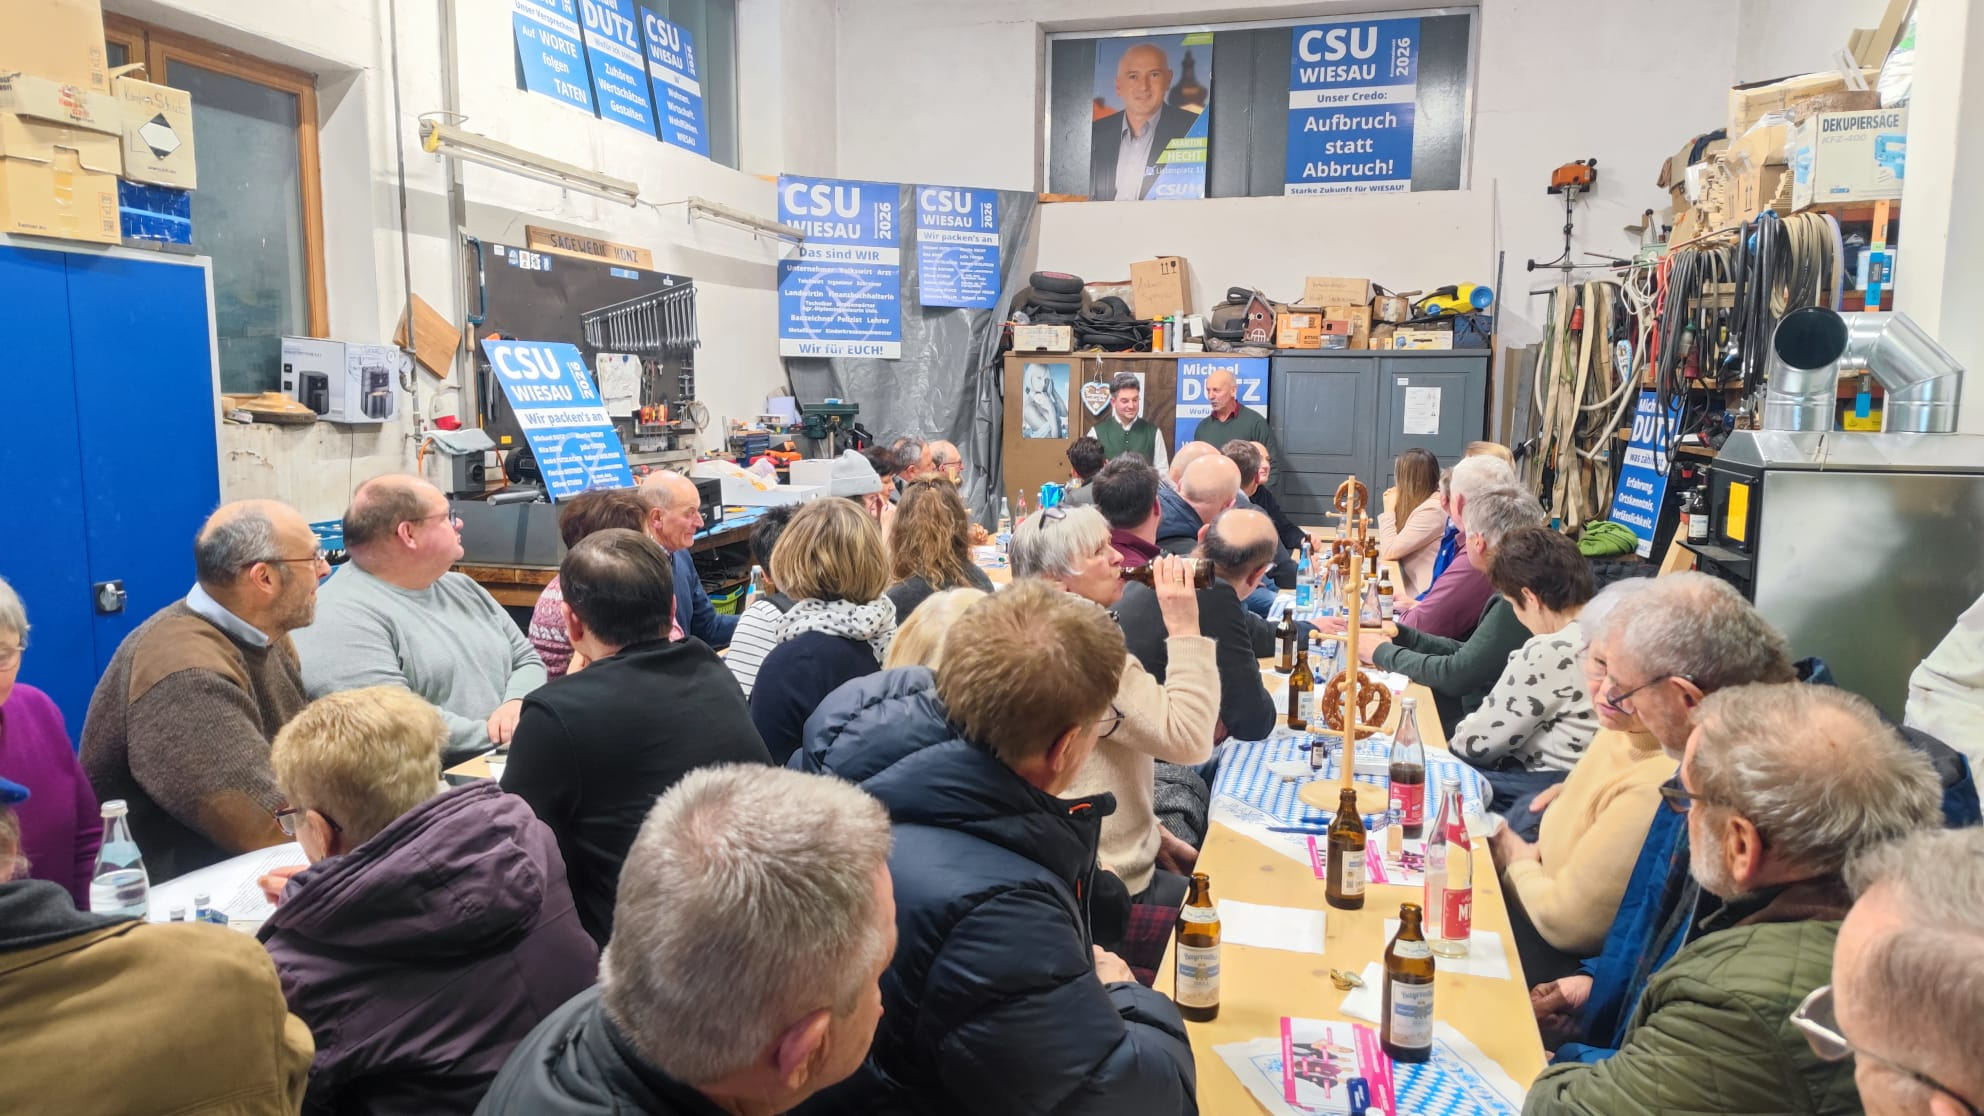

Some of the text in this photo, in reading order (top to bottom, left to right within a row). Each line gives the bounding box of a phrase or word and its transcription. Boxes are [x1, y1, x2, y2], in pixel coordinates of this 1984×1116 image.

[583, 0, 638, 49] DUTZ
[645, 14, 680, 53] CSU
[522, 25, 578, 58] Auf WORTE
[1298, 26, 1378, 63] CSU
[542, 52, 570, 74] folgen
[650, 43, 683, 71] WIESAU
[1395, 37, 1411, 77] 2026
[1300, 63, 1376, 84] WIESAU
[554, 78, 588, 104] TATEN
[1317, 91, 1388, 103] Unser Credo:
[1304, 111, 1397, 133] Aufbruch
[1325, 138, 1374, 155] statt
[1303, 159, 1394, 178] Abbruch!
[784, 183, 861, 218] CSU
[920, 190, 973, 214] CSU
[880, 203, 892, 240] 2026
[922, 214, 974, 228] WIESAU
[983, 202, 994, 229] 2026
[923, 231, 940, 241] Wir
[941, 232, 977, 246] packen's
[799, 250, 880, 264] Das sind WIR
[799, 343, 884, 356] Wir für EUCH!
[494, 346, 561, 380] CSU
[569, 361, 595, 400] 2026
[510, 384, 573, 402] WIESAU
[526, 411, 603, 427] Wir packen's an
